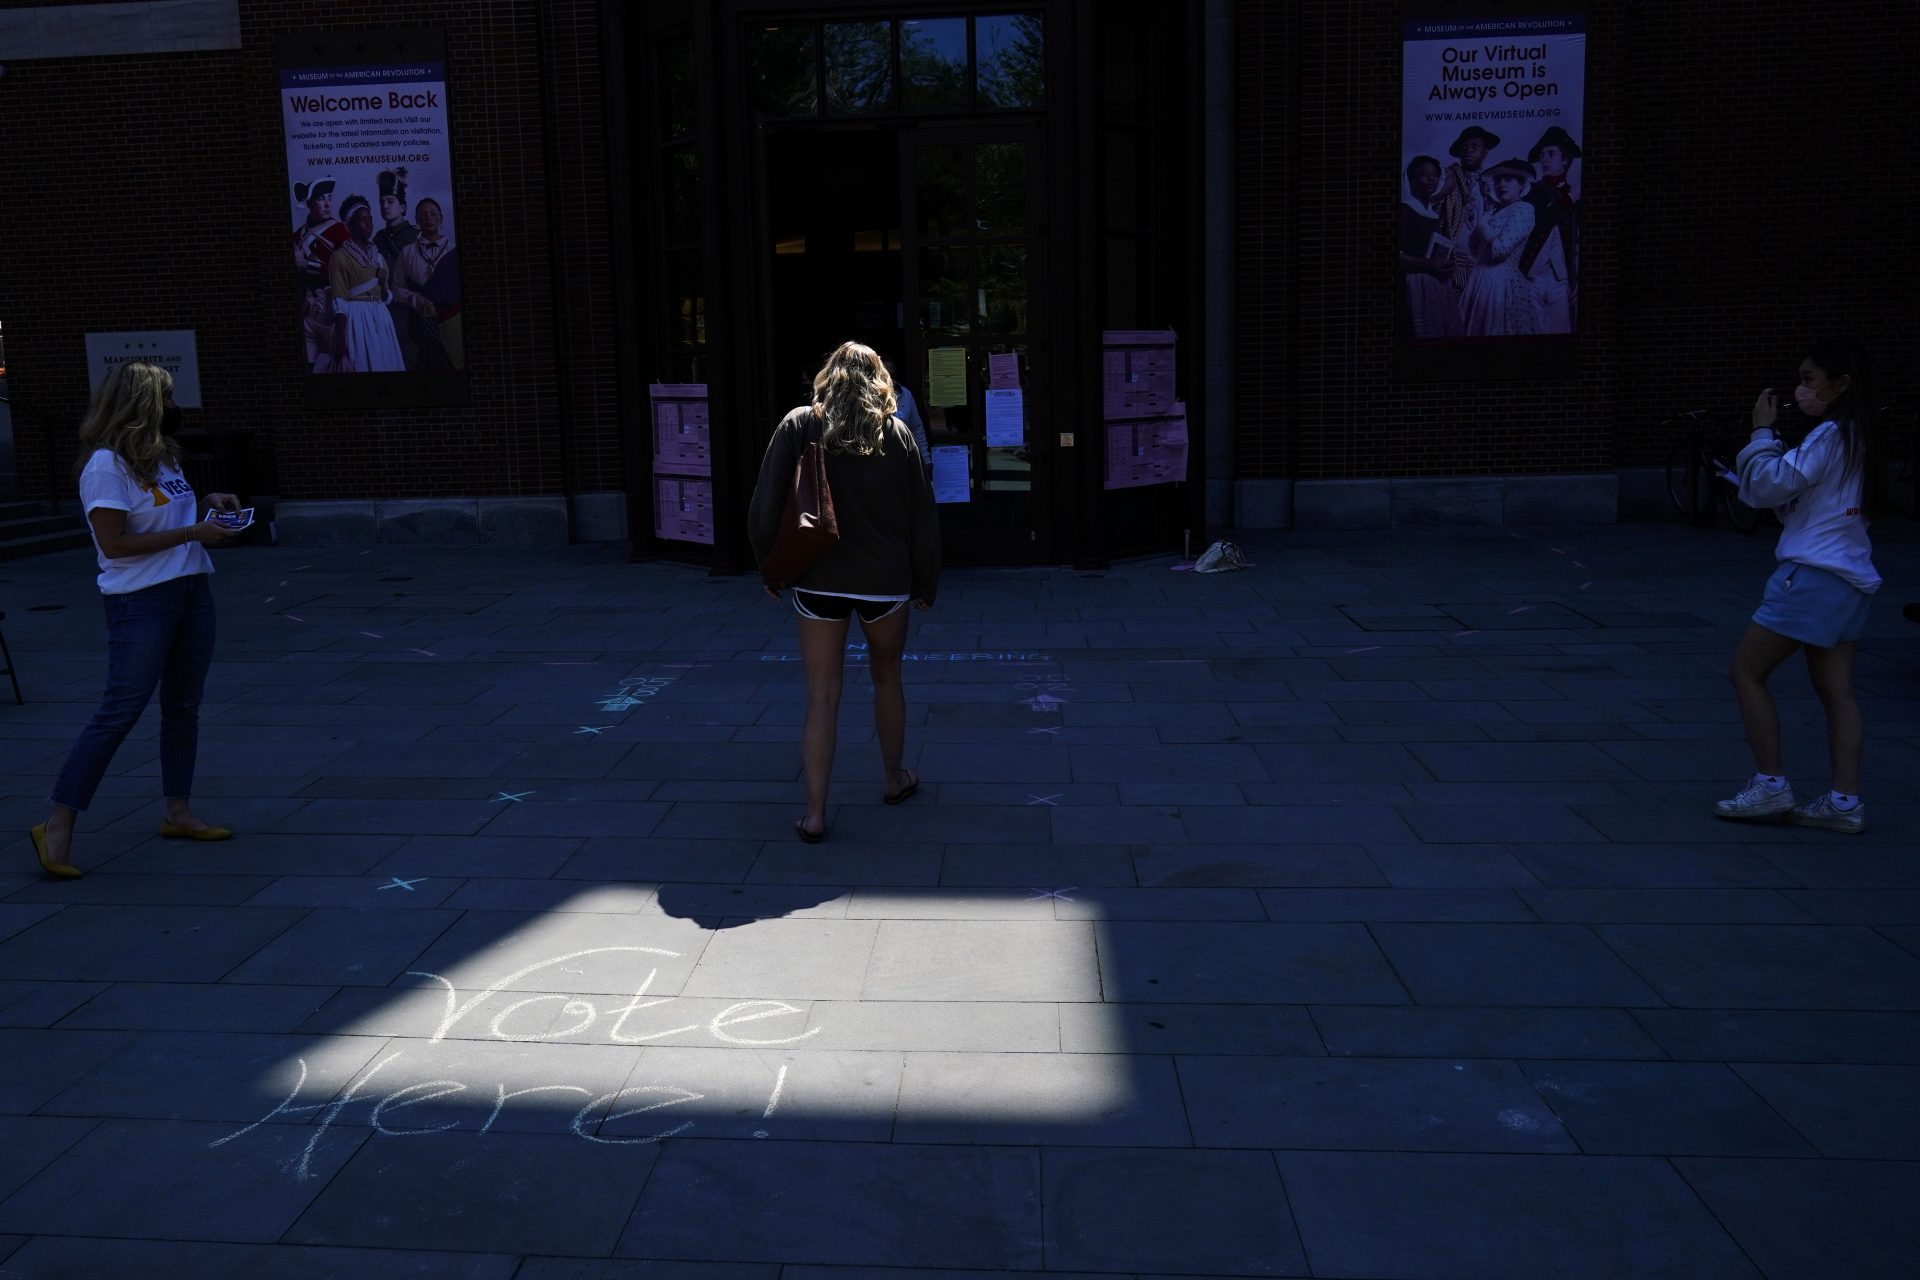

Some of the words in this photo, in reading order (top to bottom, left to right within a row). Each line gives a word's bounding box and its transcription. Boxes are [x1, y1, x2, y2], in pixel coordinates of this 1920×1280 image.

[1424, 25, 1457, 33] MUSEUM
[1475, 22, 1516, 31] AMERICAN
[1518, 20, 1566, 29] REVOLUTION
[1442, 47, 1478, 63] Our
[1484, 44, 1546, 61] Virtual
[299, 72, 328, 80] MUSEUM
[344, 70, 381, 79] AMERICAN
[382, 68, 425, 77] REVOLUTION
[1442, 66, 1525, 82] Museum
[1532, 63, 1546, 78] is
[1428, 84, 1497, 102] Always
[1504, 82, 1558, 100] Open
[290, 95, 382, 113] Welcome
[388, 90, 438, 109] Back
[1425, 108, 1561, 122] WWW.AMREVMUSEUM.ORG
[325, 120, 343, 128] open
[405, 116, 419, 124] Visit
[292, 132, 317, 140] website
[328, 130, 340, 138] the
[340, 129, 359, 137] latest
[360, 128, 399, 136] information
[410, 127, 443, 135] visitation,
[303, 142, 335, 151] ticketing,
[336, 141, 350, 149] and
[350, 140, 380, 149] updated
[381, 139, 402, 148] safety
[403, 138, 432, 147] policies.
[307, 153, 430, 166] WWW.AMREVMUSEUM.ORG
[164, 355, 182, 363] AND
[159, 479, 193, 496] VEG
[405, 946, 822, 1044] Vote
